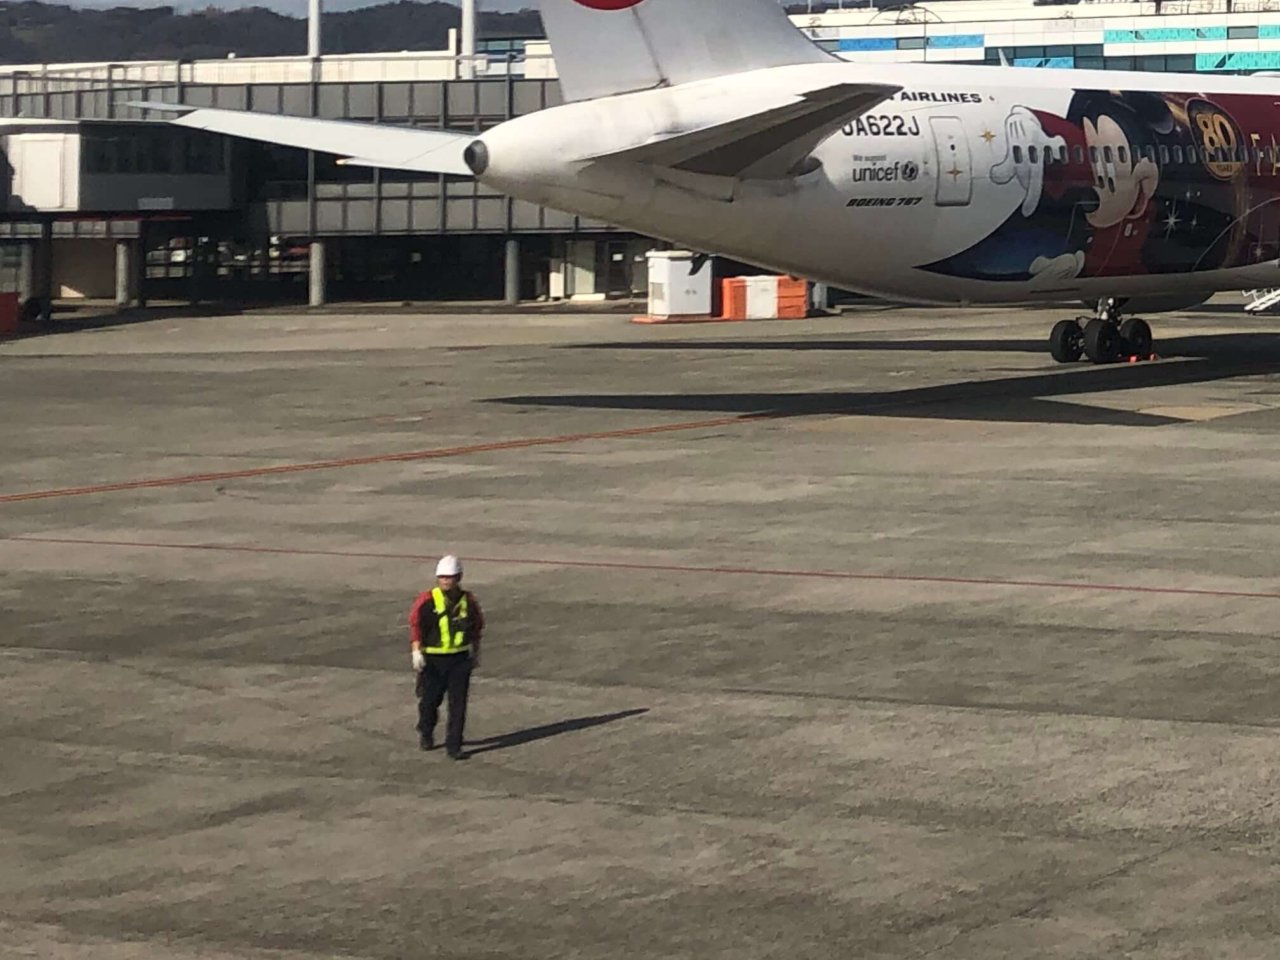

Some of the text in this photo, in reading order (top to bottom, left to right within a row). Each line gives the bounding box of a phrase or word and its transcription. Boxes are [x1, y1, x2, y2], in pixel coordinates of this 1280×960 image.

[900, 91, 982, 103] AIRLINES
[841, 114, 920, 136] JA622J
[1196, 113, 1237, 157] 80
[852, 161, 899, 182] unicef
[846, 197, 897, 208] BOEING
